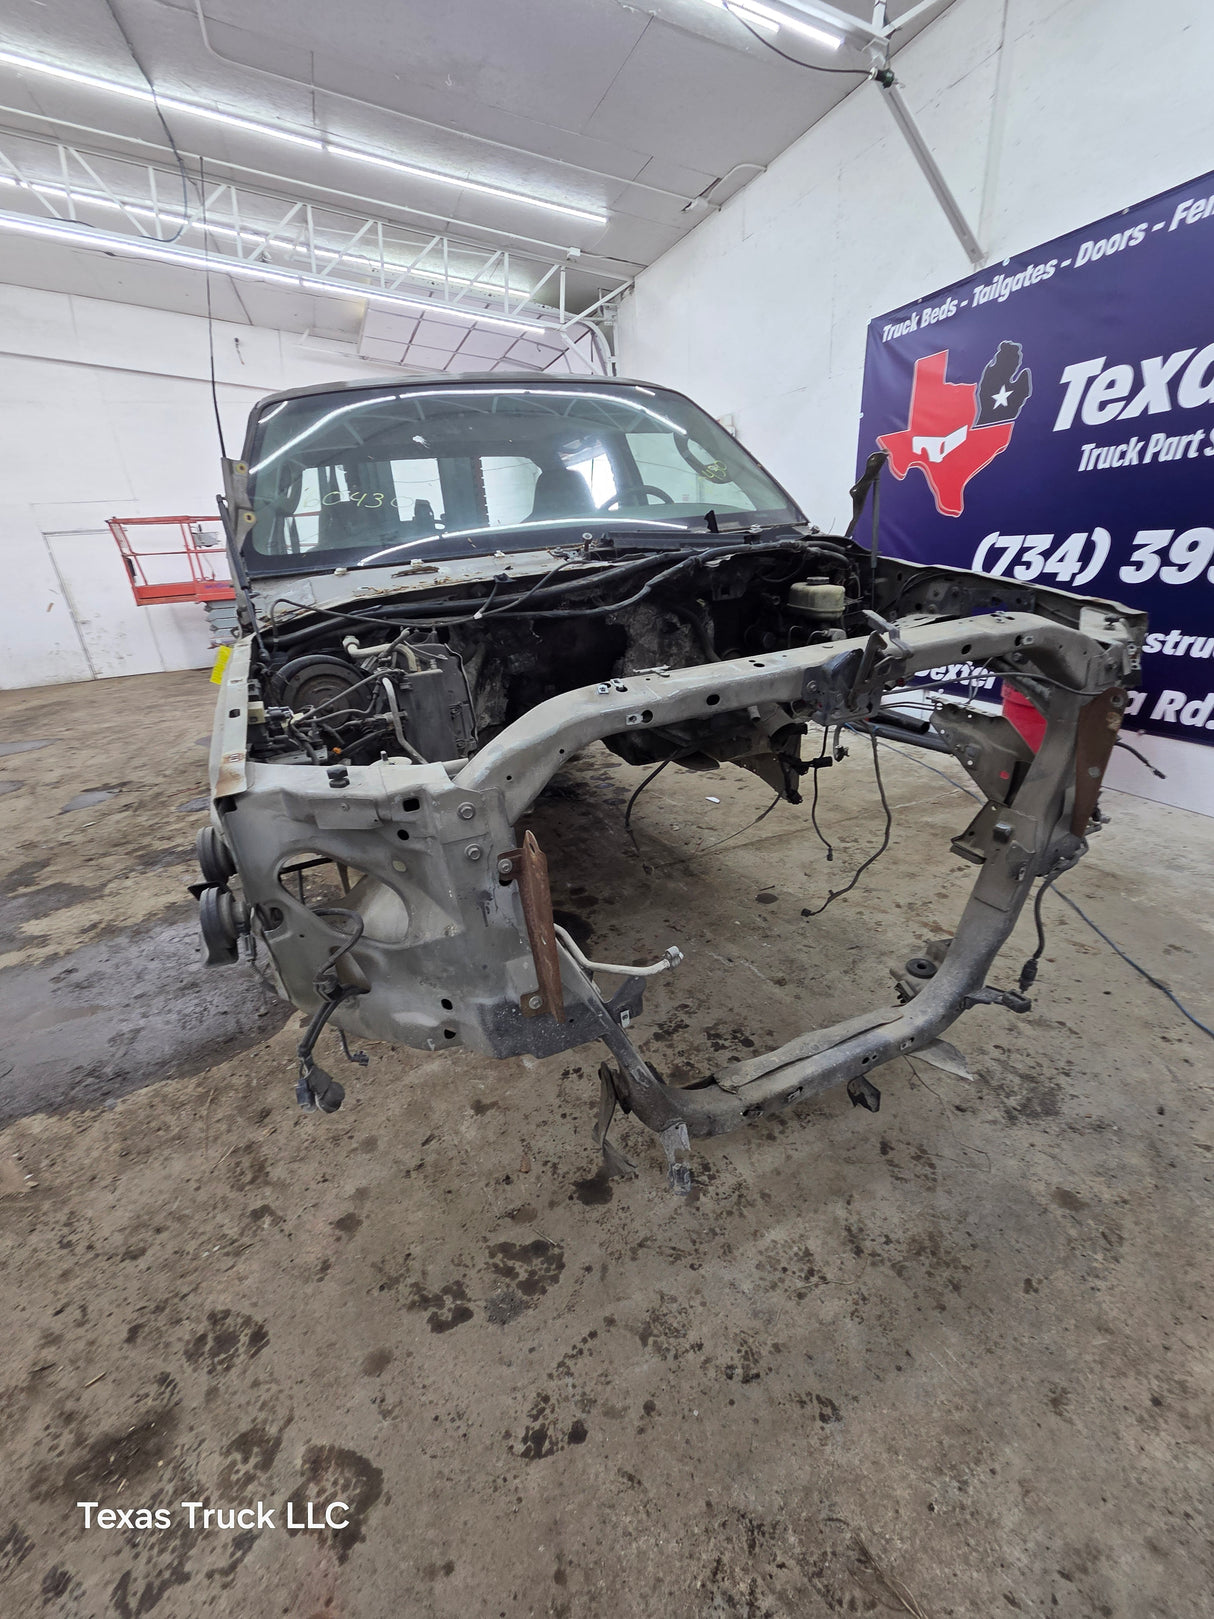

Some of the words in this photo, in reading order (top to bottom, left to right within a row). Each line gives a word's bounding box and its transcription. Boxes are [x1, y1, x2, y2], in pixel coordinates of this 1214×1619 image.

[881, 312, 920, 343] Truck
[920, 297, 957, 329] Beds
[971, 258, 1057, 308] Tailgates
[1074, 222, 1149, 269] Doors
[1078, 436, 1146, 472] Truck
[1142, 429, 1206, 464] Part
[971, 527, 1111, 586] (734)
[1119, 527, 1214, 585] 39
[1141, 629, 1214, 659] stru
